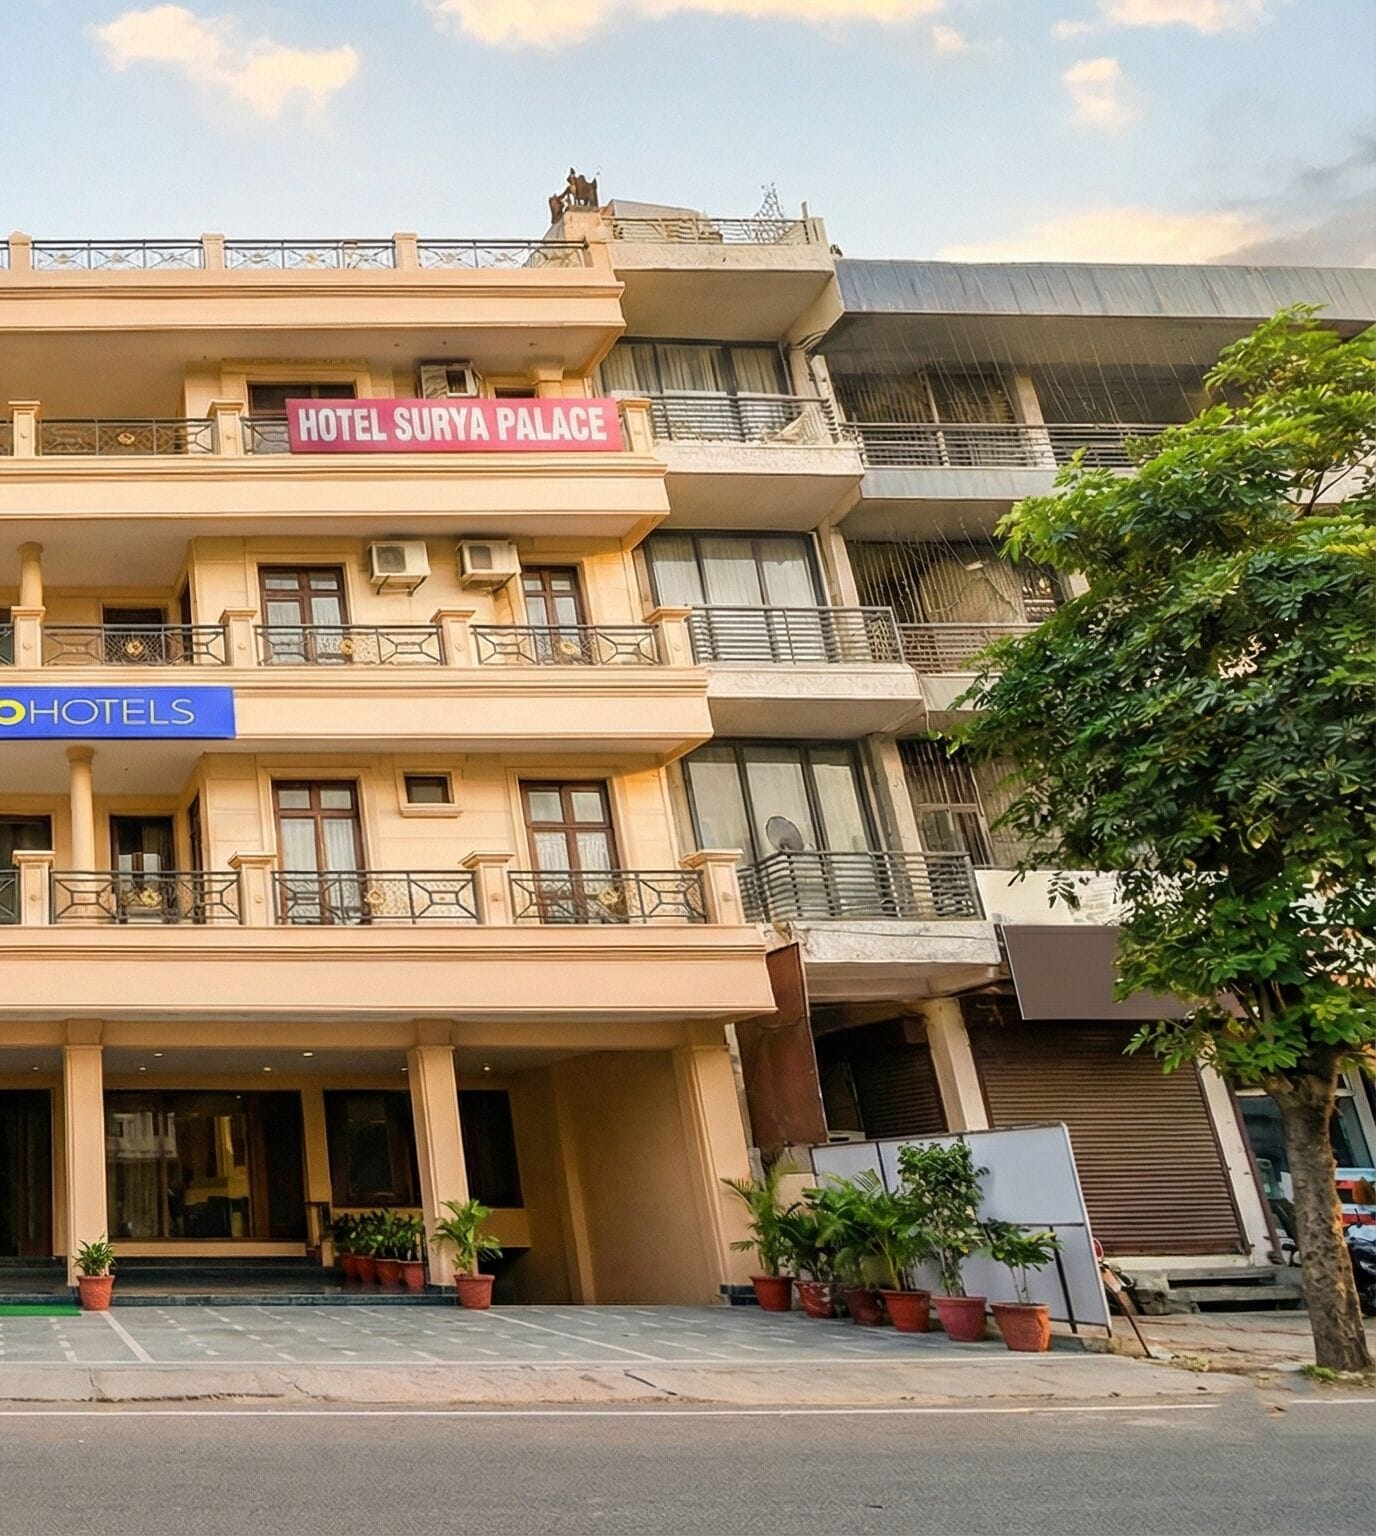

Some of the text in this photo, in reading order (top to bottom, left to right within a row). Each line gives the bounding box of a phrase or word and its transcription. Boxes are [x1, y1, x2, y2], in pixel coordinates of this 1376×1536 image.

[298, 407, 608, 441] HOTEL SURYA PALACE
